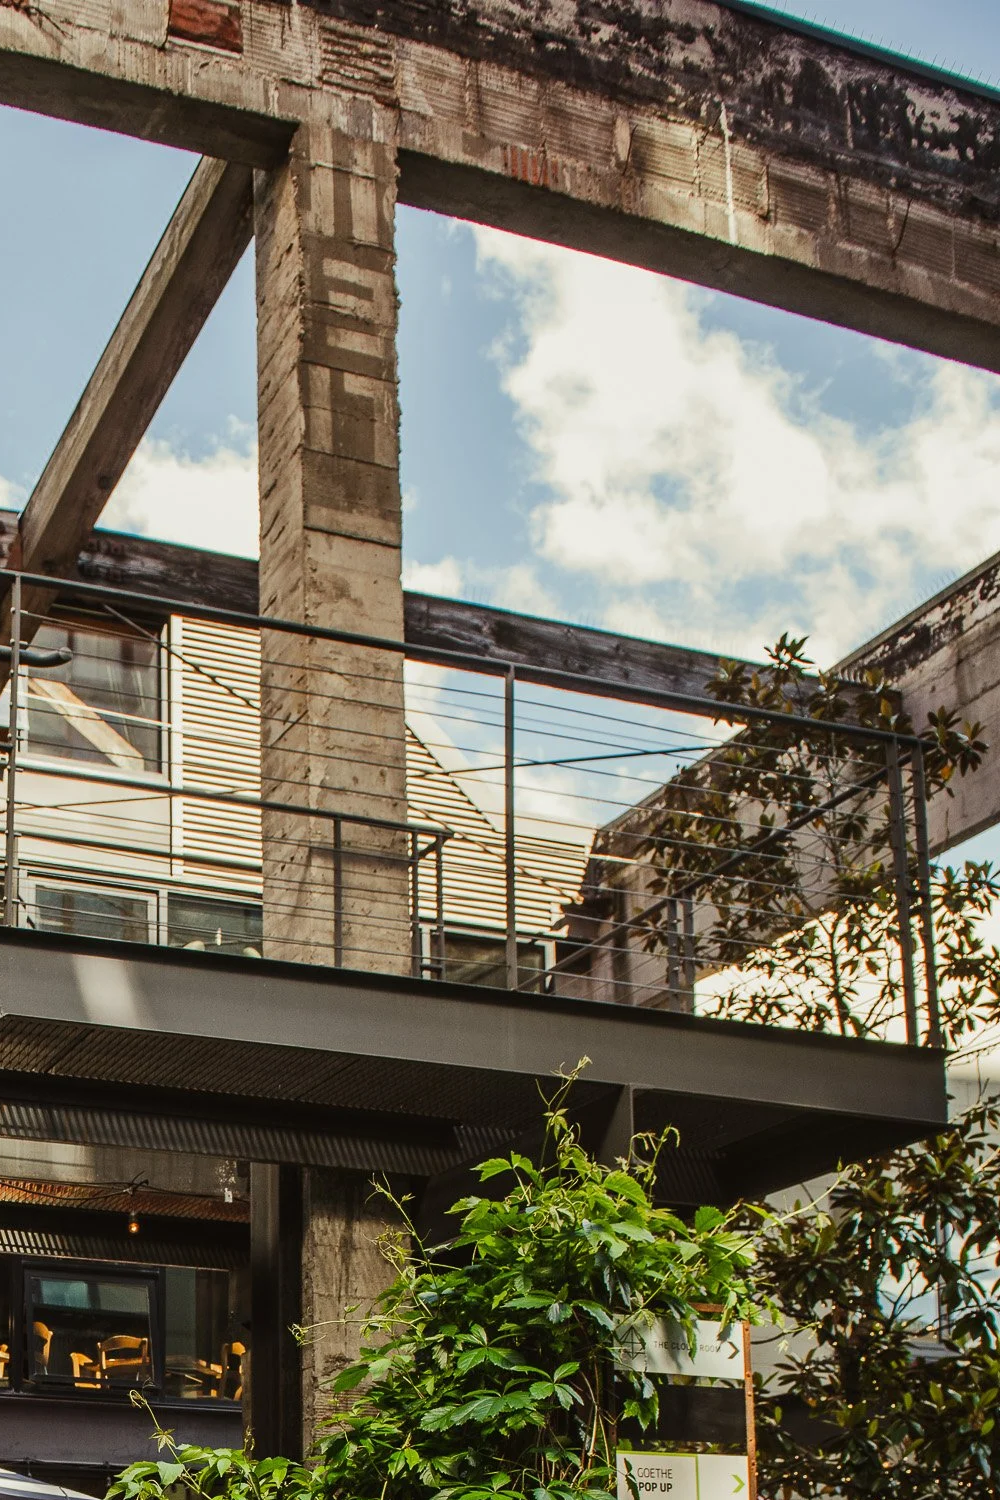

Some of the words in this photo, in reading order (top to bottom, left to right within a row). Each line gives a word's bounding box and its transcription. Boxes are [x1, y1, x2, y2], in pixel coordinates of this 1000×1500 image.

[654, 1341, 669, 1350] THE
[637, 1467, 673, 1479] GOETHE
[638, 1482, 657, 1492] POP
[660, 1483, 673, 1493] UP
